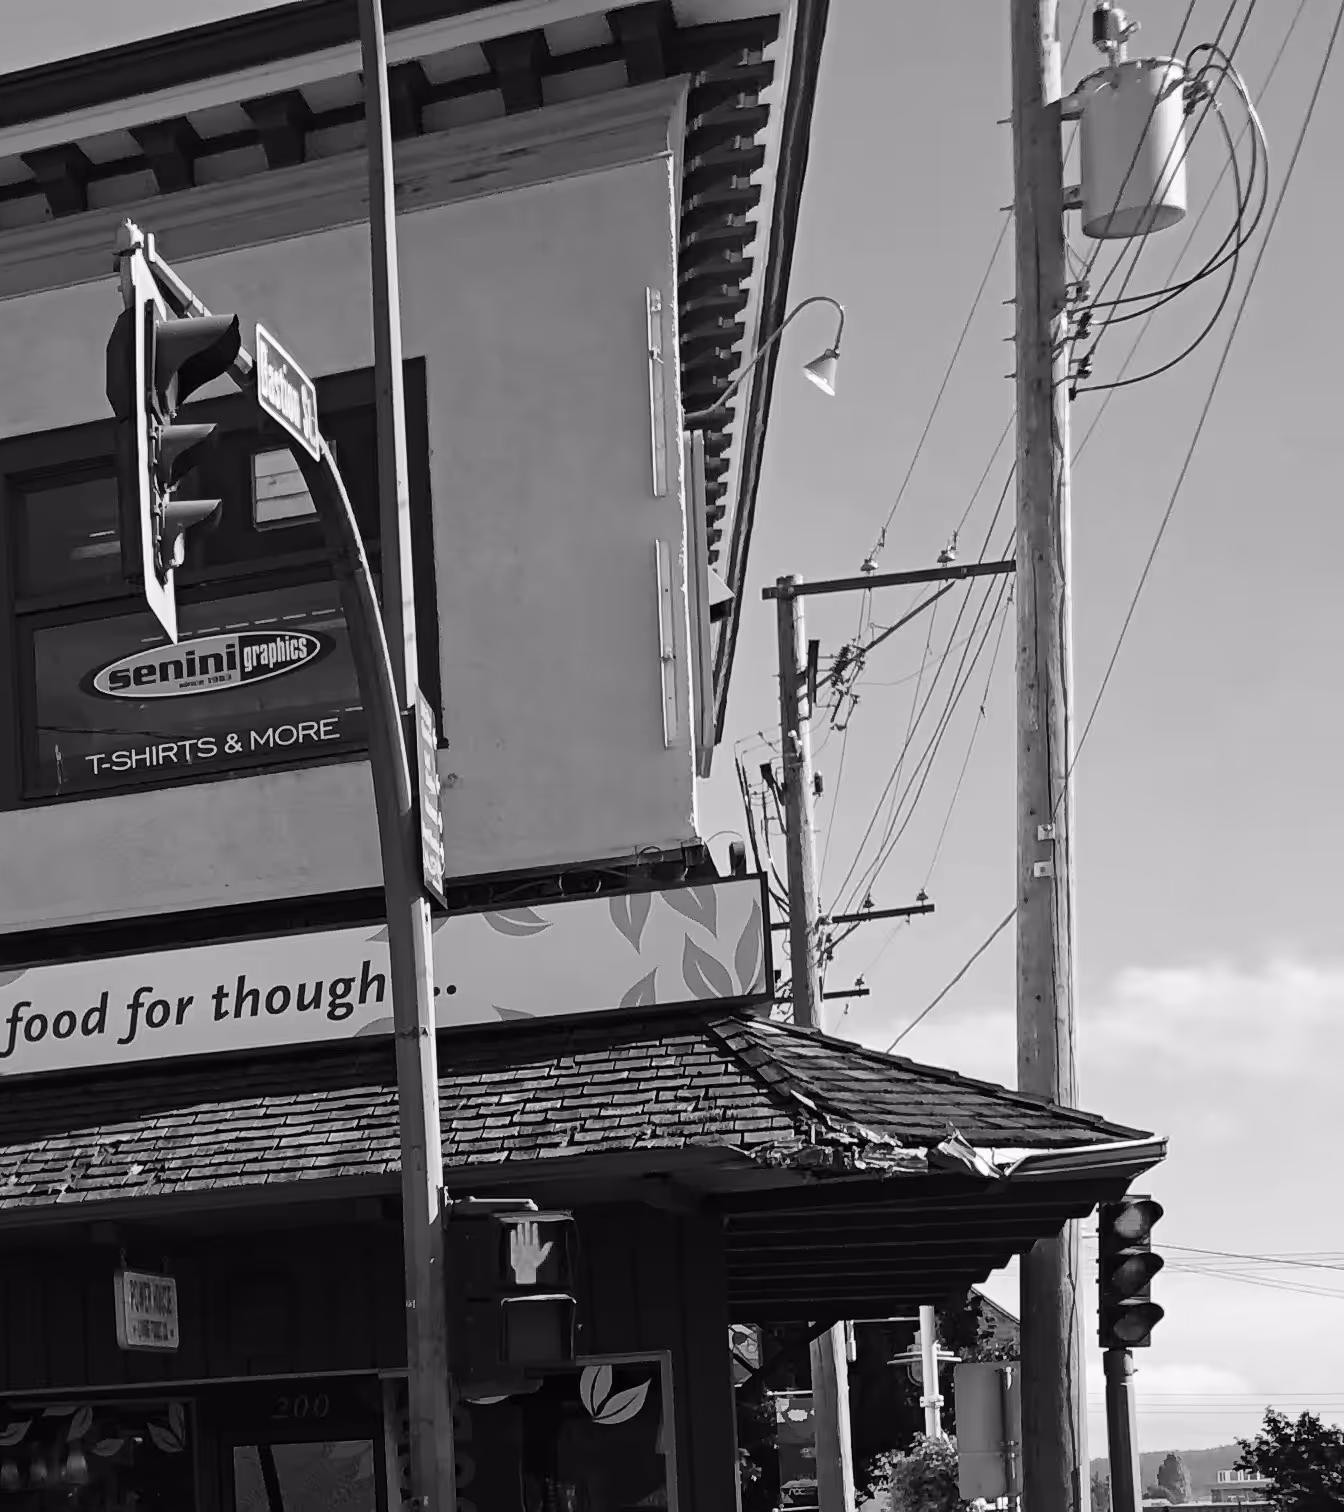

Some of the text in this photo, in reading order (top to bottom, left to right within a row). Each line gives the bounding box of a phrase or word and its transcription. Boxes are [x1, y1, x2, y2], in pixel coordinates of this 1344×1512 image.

[108, 636, 308, 691] senini graphics
[85, 717, 341, 775] T-SHIRTS & MORE
[117, 986, 194, 1045] for
